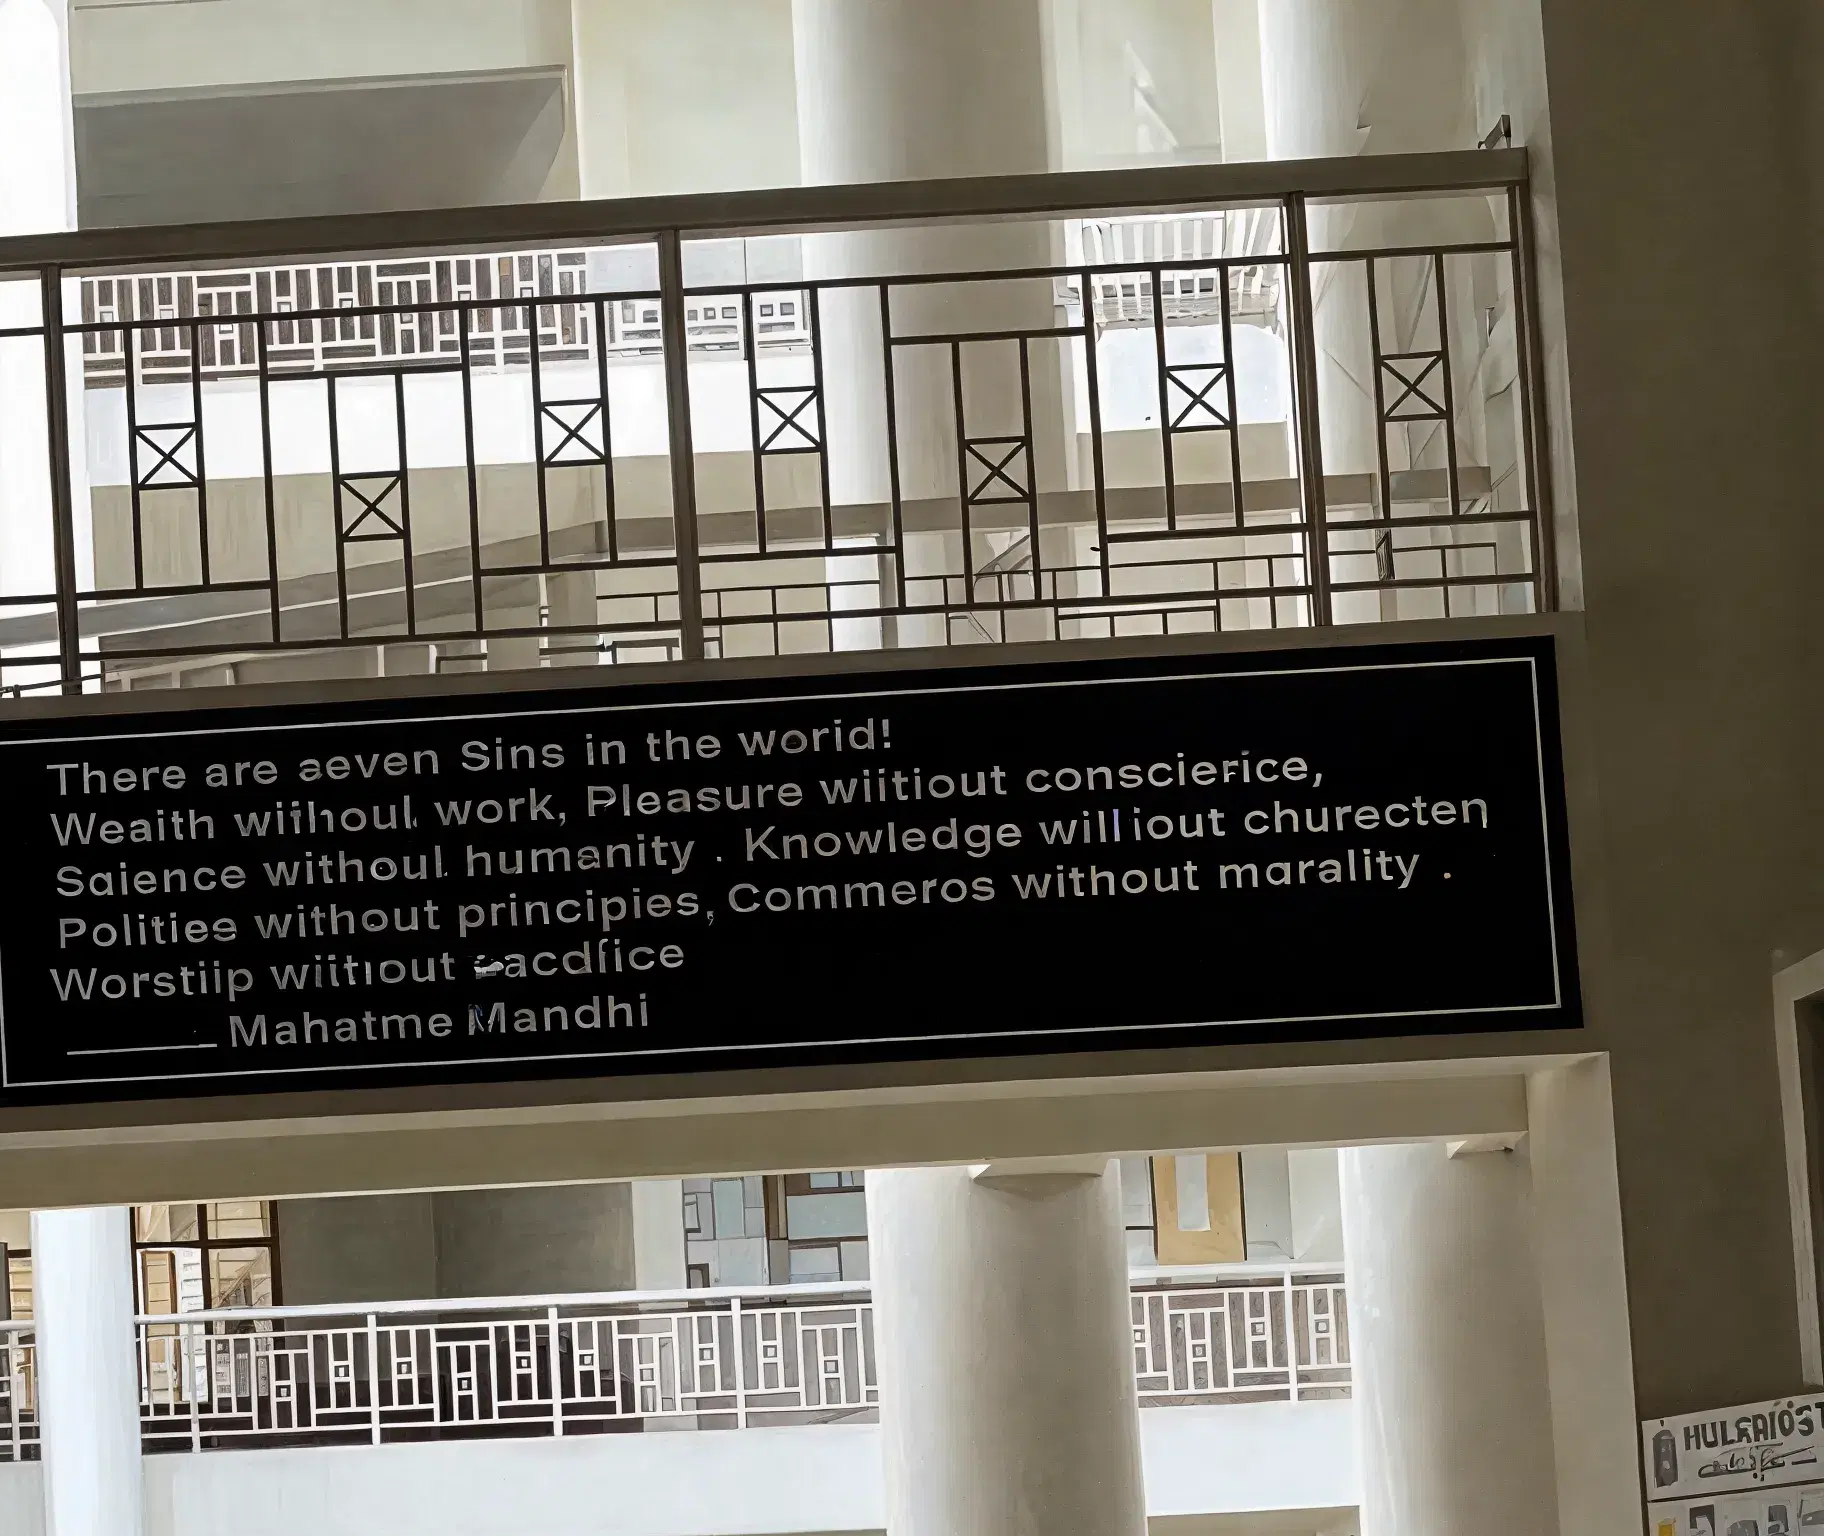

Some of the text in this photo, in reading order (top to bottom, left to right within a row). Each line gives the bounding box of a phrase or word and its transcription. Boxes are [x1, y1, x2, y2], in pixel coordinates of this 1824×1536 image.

[47, 762, 186, 796] There
[206, 761, 278, 788] are
[462, 738, 565, 772] Sins
[586, 734, 626, 766] in
[647, 730, 721, 762] the
[434, 788, 566, 827] work,
[588, 783, 803, 817] Pleasure
[467, 834, 695, 876] humanity
[746, 818, 1023, 861] Knowledge
[254, 900, 441, 939] without
[1012, 861, 1200, 900] without
